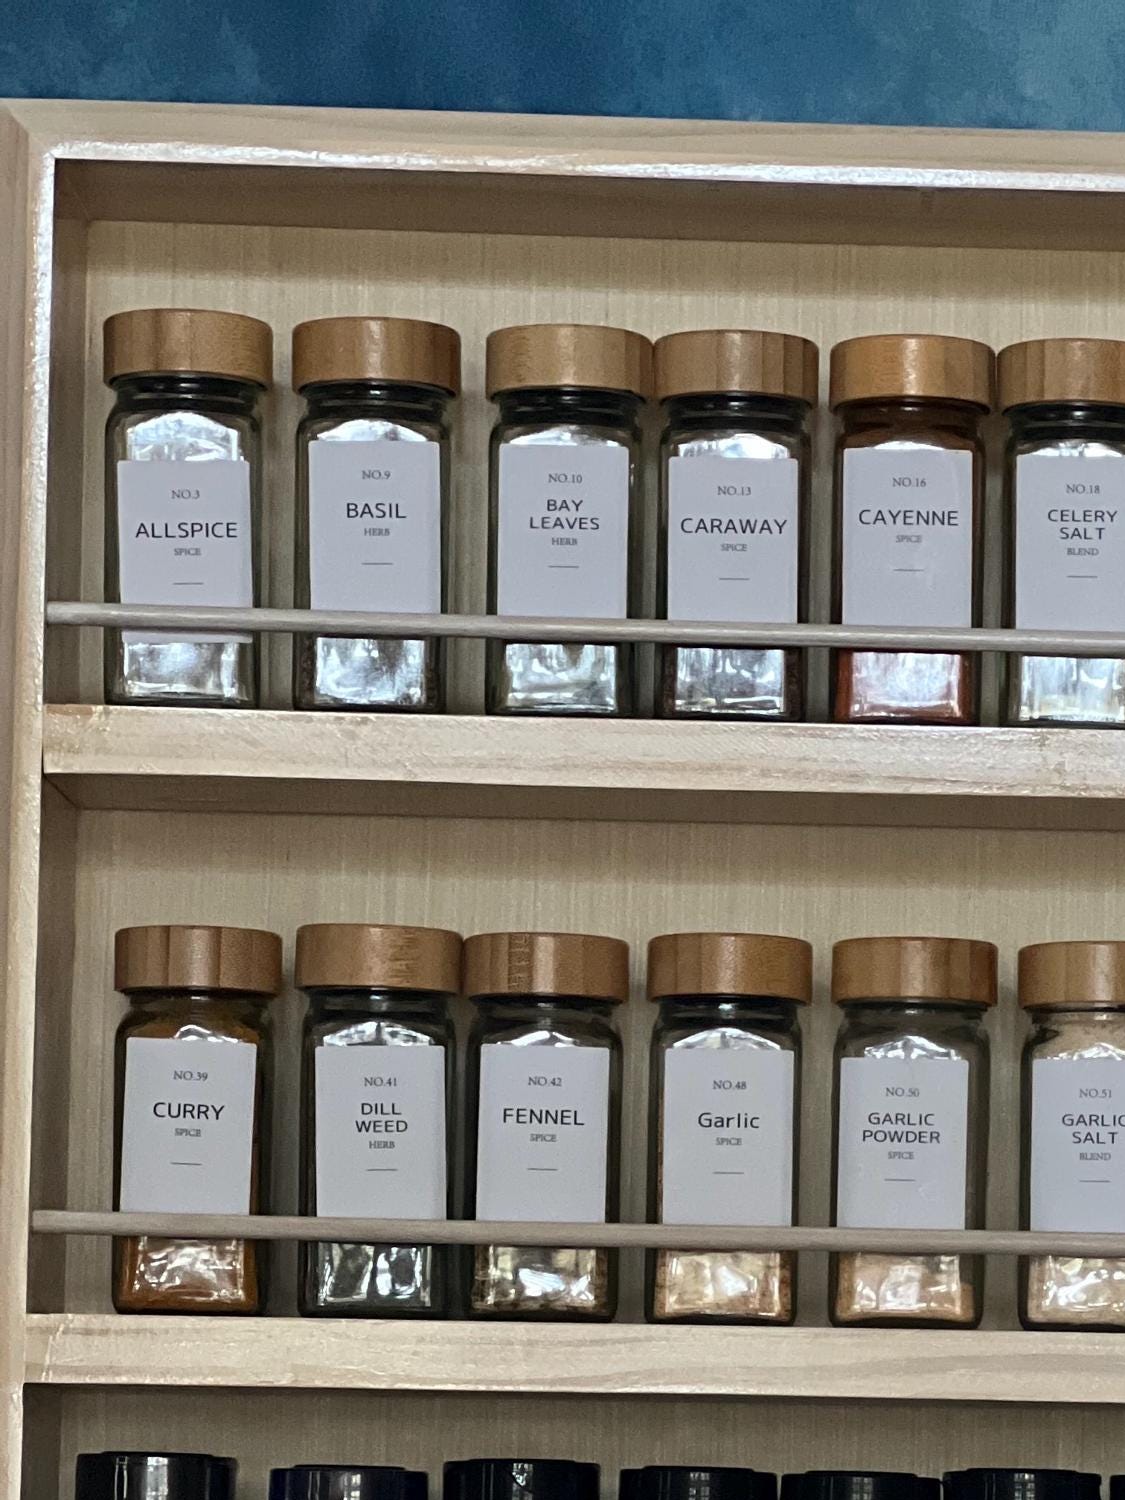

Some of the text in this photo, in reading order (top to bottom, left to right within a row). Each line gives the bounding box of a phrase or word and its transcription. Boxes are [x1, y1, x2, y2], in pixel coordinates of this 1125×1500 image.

[346, 503, 407, 519] BASIL
[547, 499, 584, 512] BAY
[530, 516, 600, 530] LEAVES
[859, 509, 960, 527] CAYENNE
[1047, 509, 1118, 523] CELERY
[136, 522, 239, 539] ALLSPICE
[680, 518, 787, 535] CARAWAY
[1059, 527, 1106, 540] SALT
[153, 1102, 226, 1120] CURRY
[361, 1103, 402, 1116] DILL
[503, 1107, 585, 1126] FENNEL
[698, 1112, 760, 1129] Garlic
[868, 1112, 936, 1126] GARLIC
[355, 1120, 408, 1133] WEED
[862, 1130, 941, 1144] POWDER
[1072, 1131, 1118, 1144] SALT
